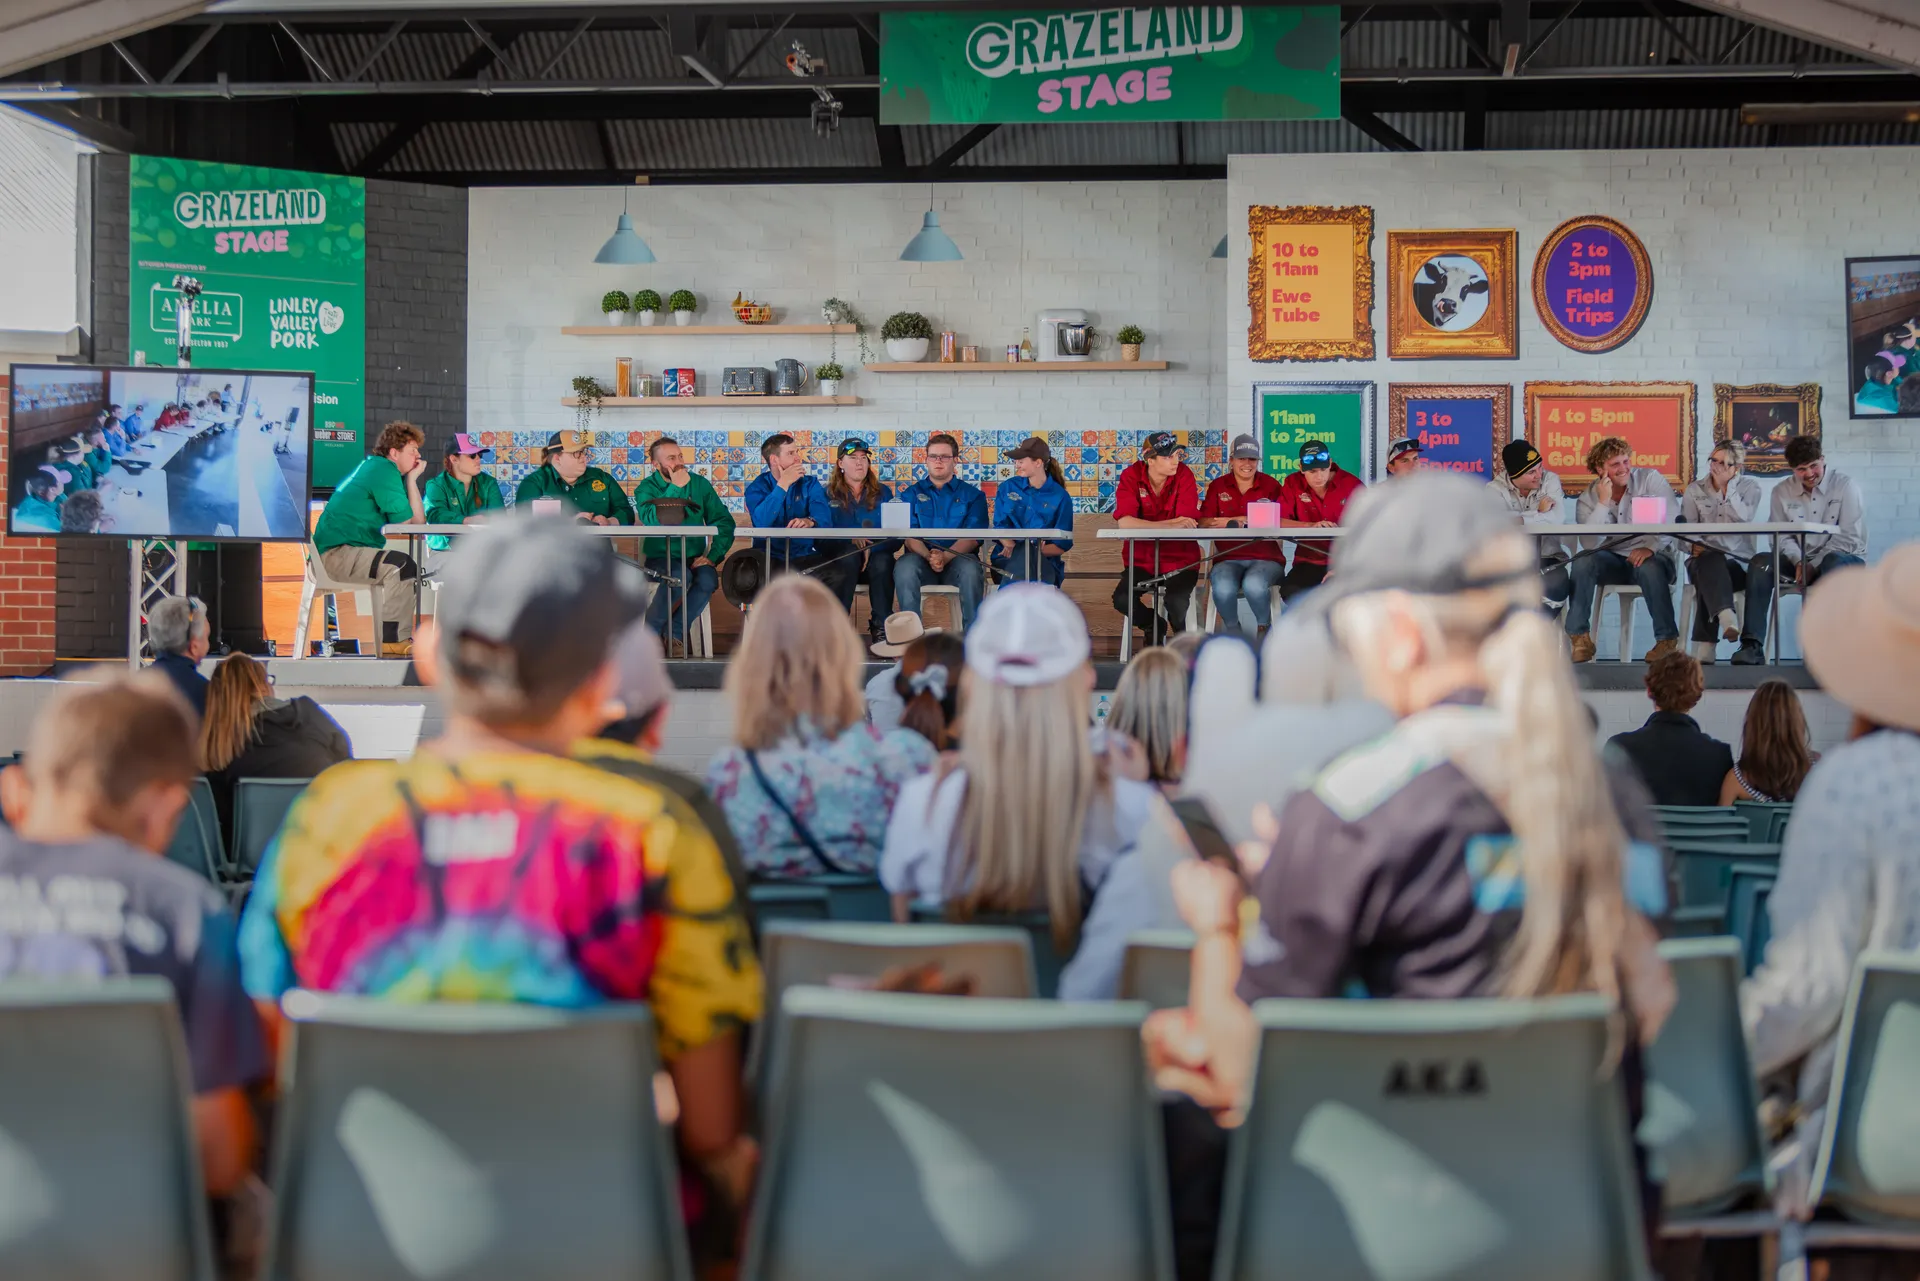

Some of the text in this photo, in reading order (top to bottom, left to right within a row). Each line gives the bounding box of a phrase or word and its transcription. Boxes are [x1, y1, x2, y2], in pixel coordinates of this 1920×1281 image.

[967, 6, 1242, 76] GRAZELAND
[1036, 66, 1173, 113] STAGE
[174, 190, 325, 227] GRAZELAND
[214, 230, 289, 254] STAGE
[1271, 242, 1319, 258] 10 to
[1571, 241, 1609, 257] 2 to
[1271, 261, 1319, 276] 11am
[1568, 261, 1611, 280] 3pm
[1272, 288, 1312, 304] Ewe
[1566, 287, 1615, 304] Field
[161, 297, 233, 317] AELIA
[269, 296, 319, 315] LINLEY
[1272, 307, 1321, 322] Tube
[190, 316, 211, 327] ARK
[269, 313, 318, 332] VALLEY
[1565, 306, 1614, 327] Trips
[270, 329, 320, 350] PORK
[313, 392, 339, 405] ision
[1269, 409, 1316, 425] 11am
[1415, 411, 1453, 427] 3 to
[1548, 407, 1635, 427] 4 to 5pm
[336, 431, 355, 441] STORE
[1269, 428, 1290, 444] to
[1418, 429, 1460, 449] 4pm
[1548, 431, 1584, 452] Hay
[1547, 450, 1588, 466] Gol
